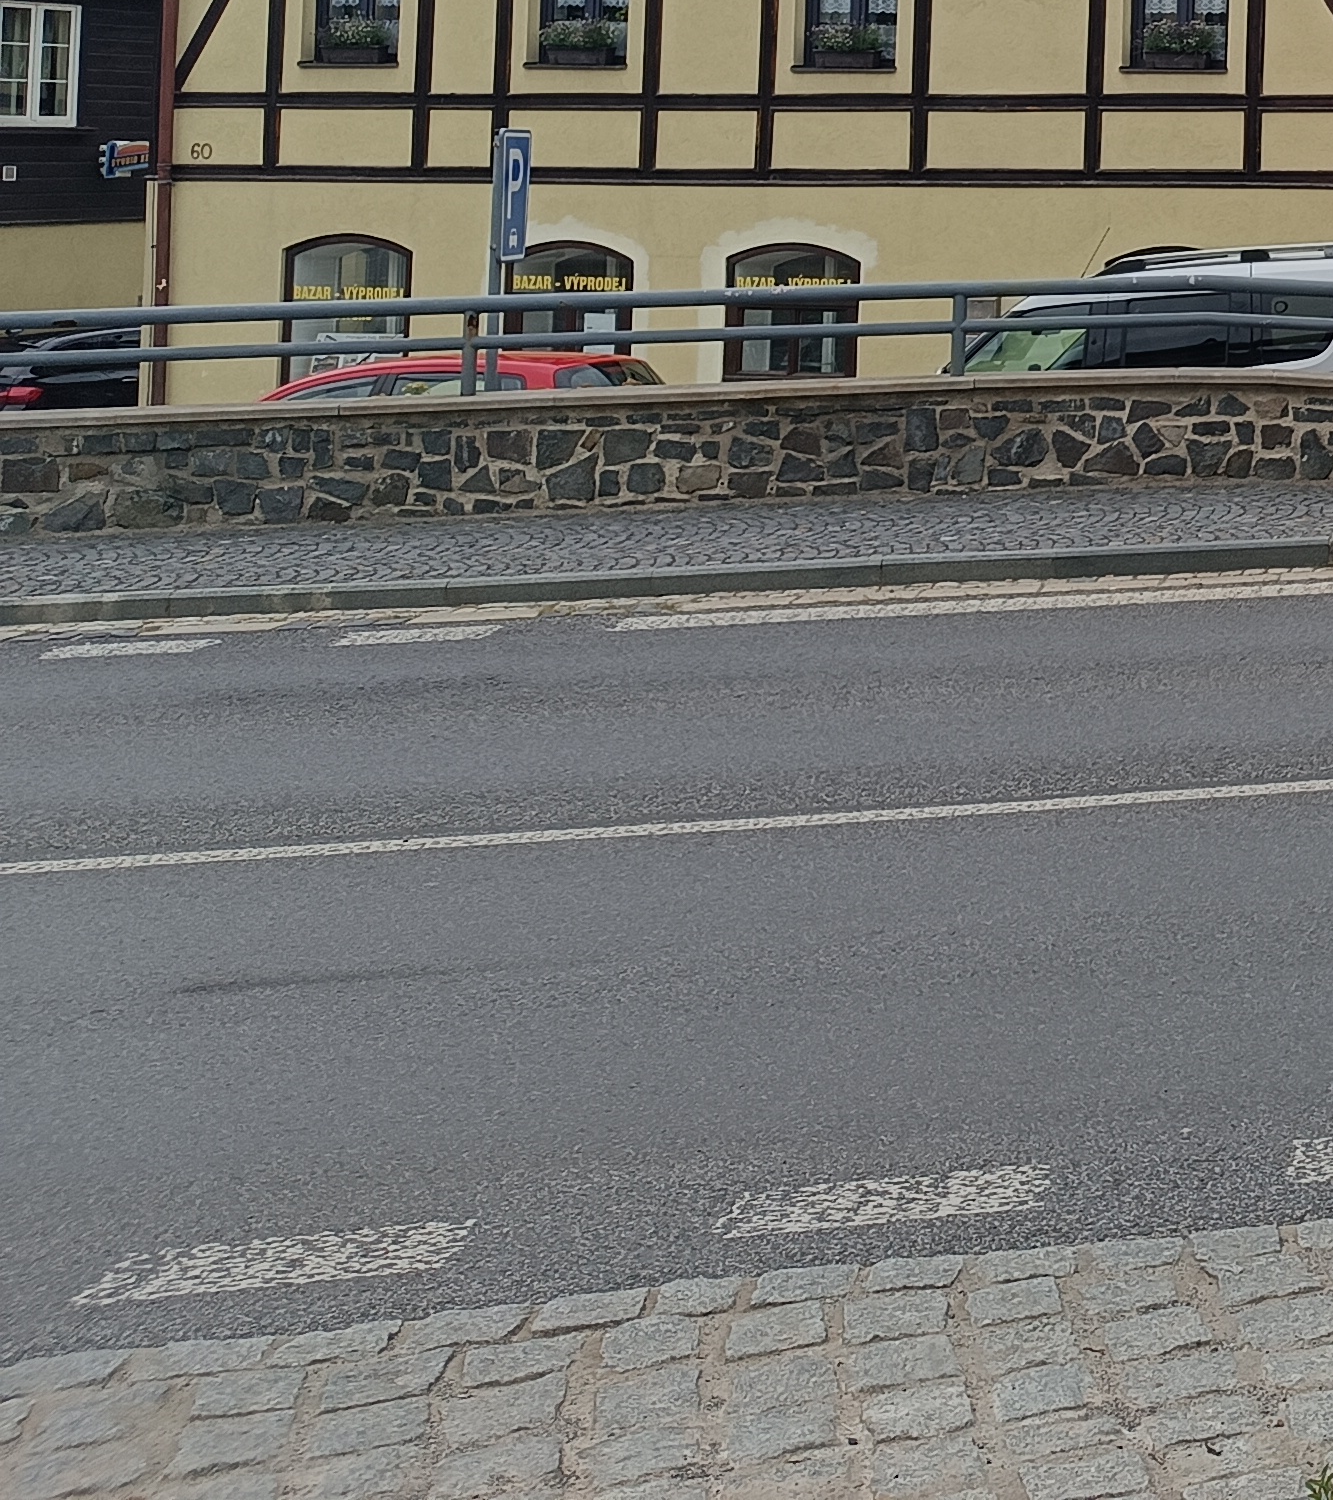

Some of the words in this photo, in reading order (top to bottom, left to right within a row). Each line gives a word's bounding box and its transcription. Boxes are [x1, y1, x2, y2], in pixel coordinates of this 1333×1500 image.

[190, 142, 213, 160] 60
[506, 148, 524, 220] P
[512, 274, 552, 290] BAZAR
[564, 272, 627, 291] VÝPRODEJ
[293, 285, 332, 300] BAZAR
[343, 283, 405, 300] VÝPRODEJ
